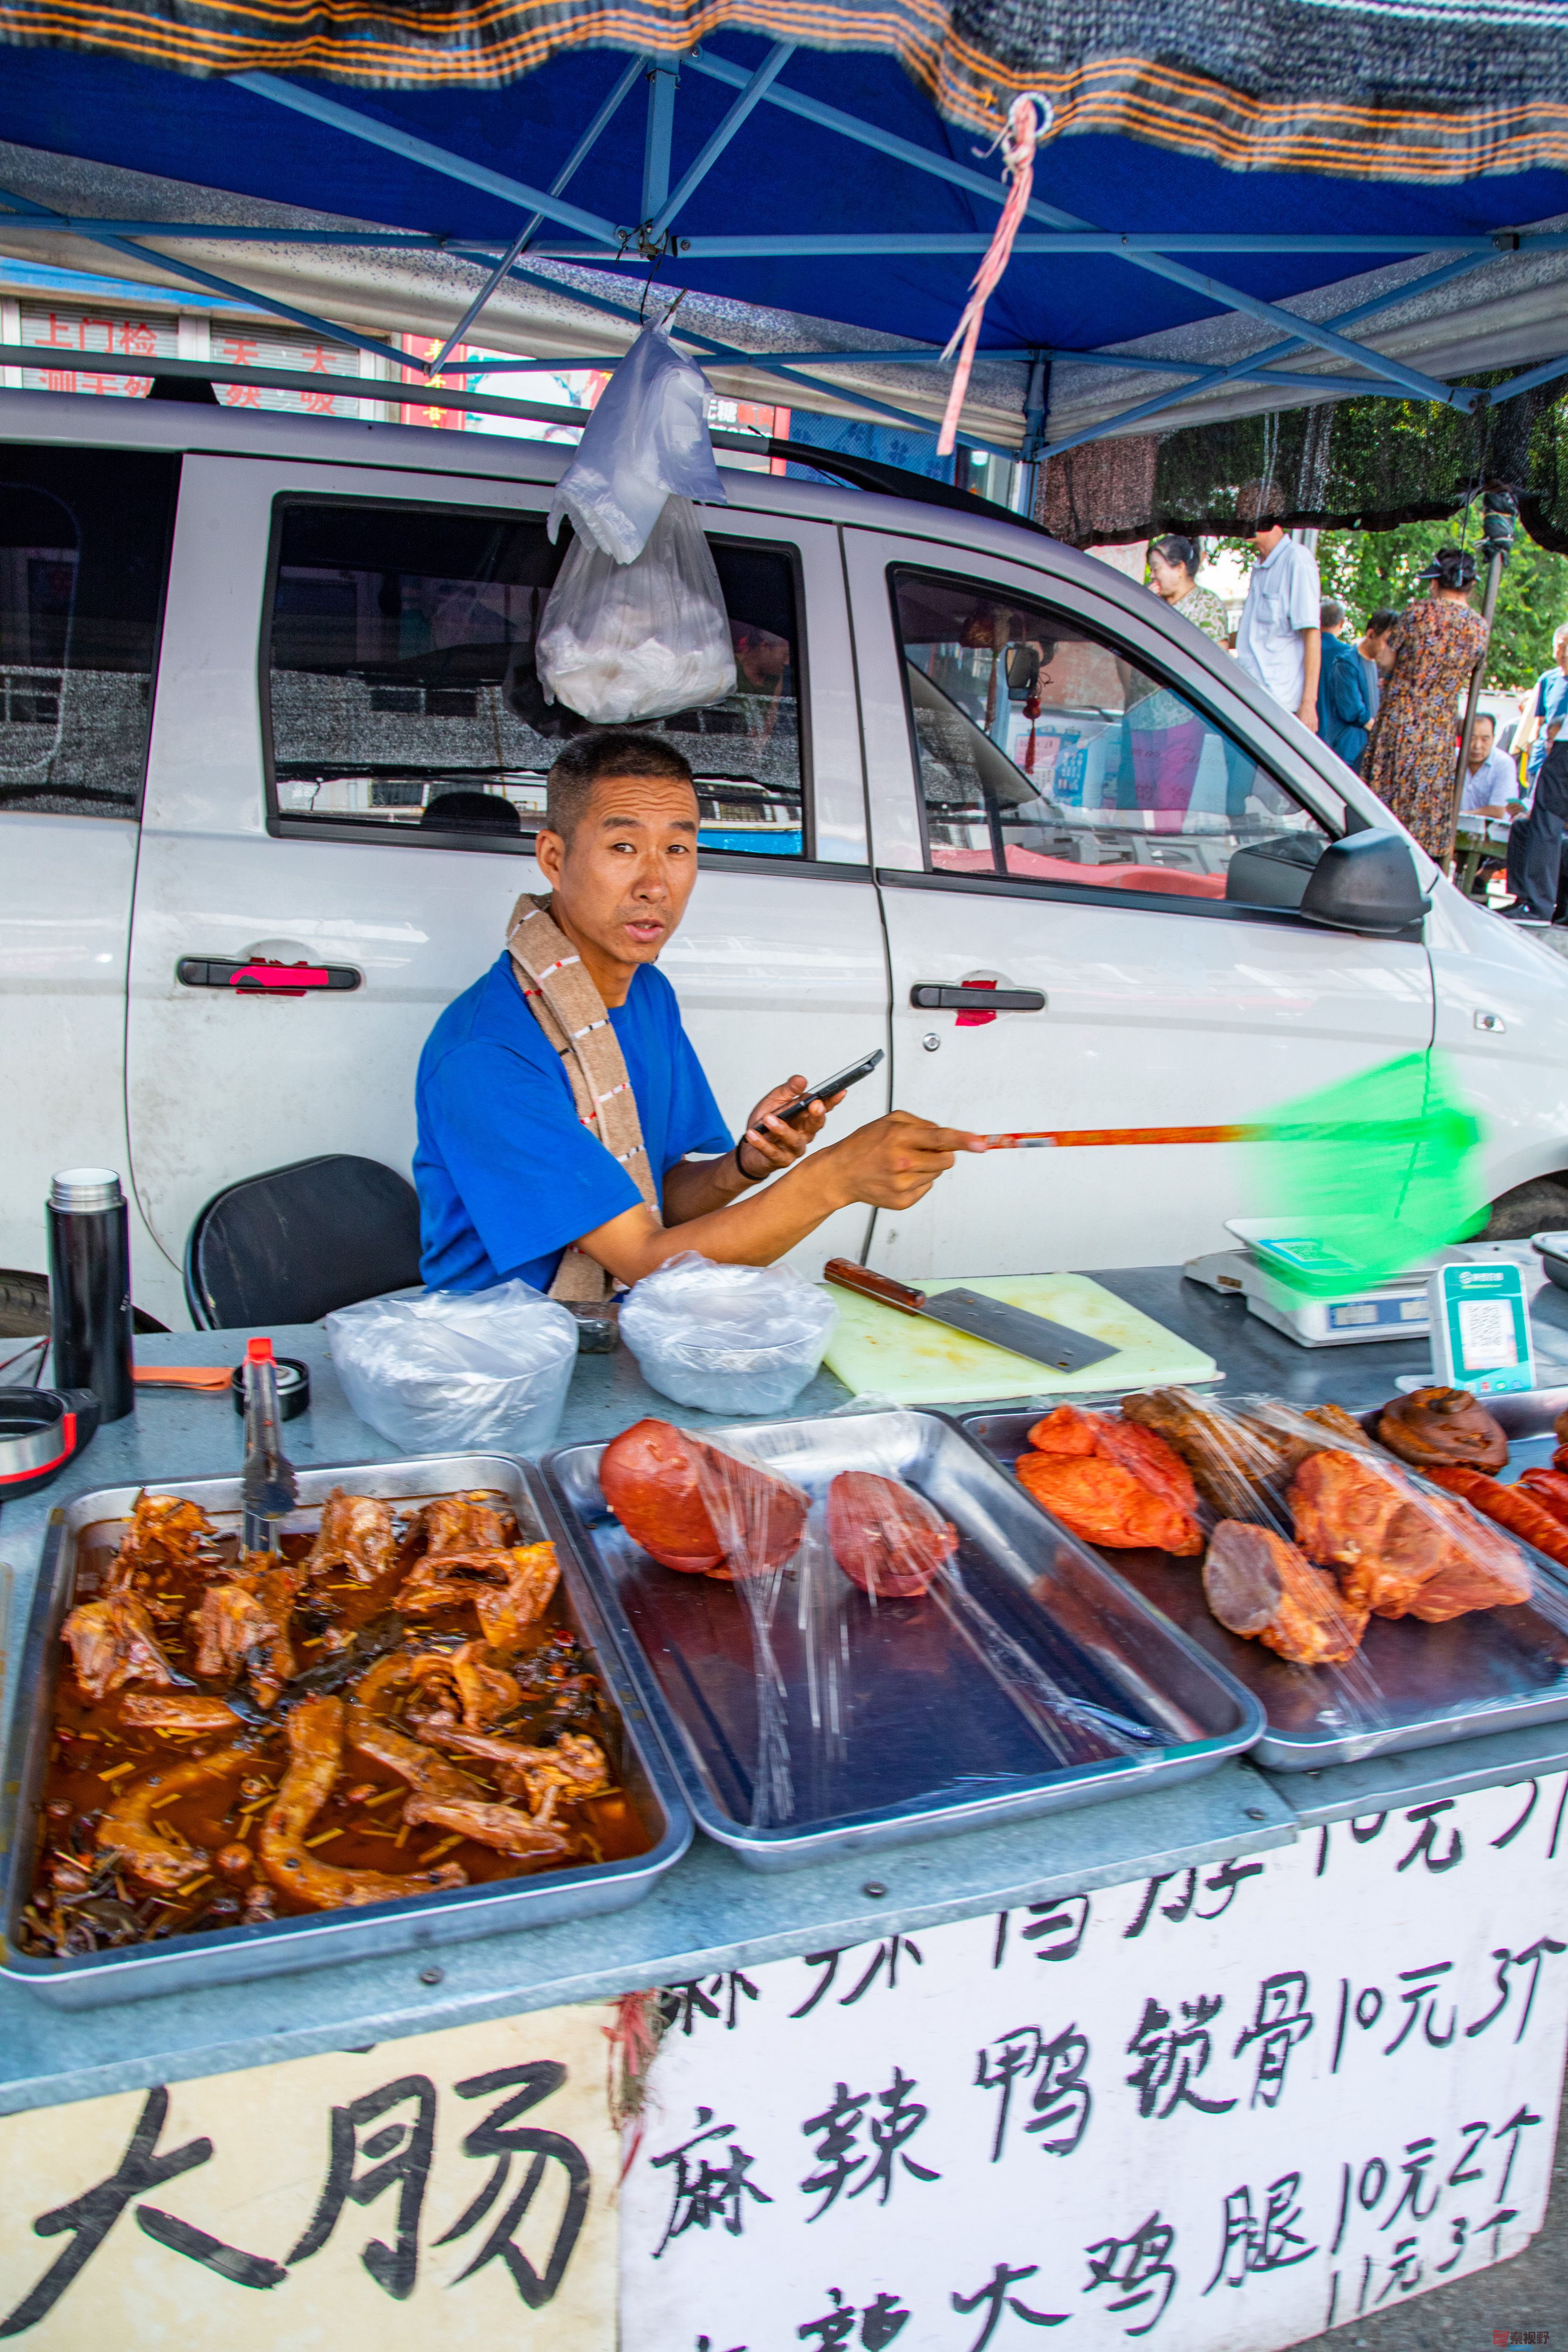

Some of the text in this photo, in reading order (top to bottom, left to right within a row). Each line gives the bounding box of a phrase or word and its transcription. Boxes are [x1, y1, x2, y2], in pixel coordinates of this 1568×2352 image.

[34, 313, 158, 358] 上门检
[0, 2059, 591, 2338] 大肠
